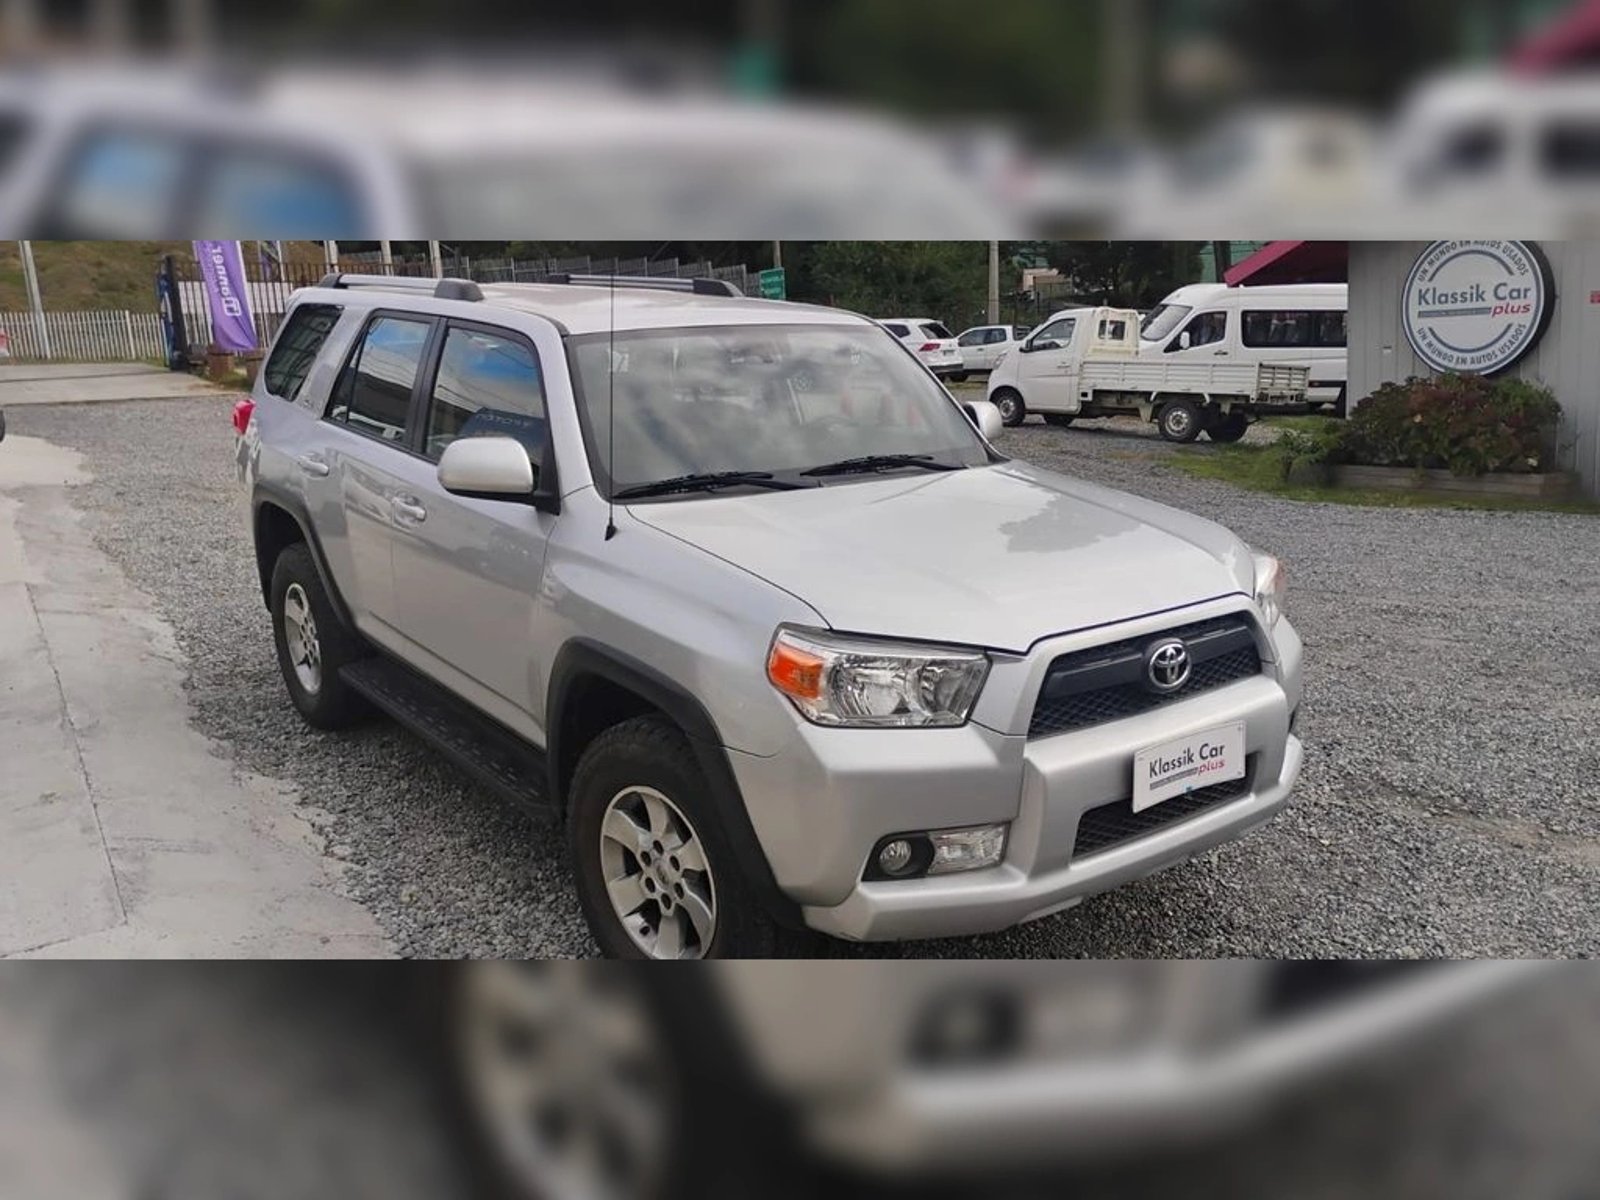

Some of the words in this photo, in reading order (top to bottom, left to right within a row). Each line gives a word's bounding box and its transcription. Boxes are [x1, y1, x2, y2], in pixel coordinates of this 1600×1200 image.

[1418, 270, 1429, 282] UN
[1428, 243, 1457, 269] MUNDO
[1502, 245, 1529, 276] USADOS
[1418, 283, 1486, 306] Klassik
[1493, 282, 1531, 301] Car
[1491, 302, 1531, 318] plus
[1417, 327, 1428, 341] UN
[1425, 341, 1454, 363] MUNDO
[1455, 356, 1468, 366] EN
[1469, 350, 1499, 365] AUTOS
[1499, 323, 1527, 355] USADOS
[1149, 747, 1195, 778] Klassik
[1199, 743, 1225, 760] Car
[1198, 759, 1225, 776] plus
